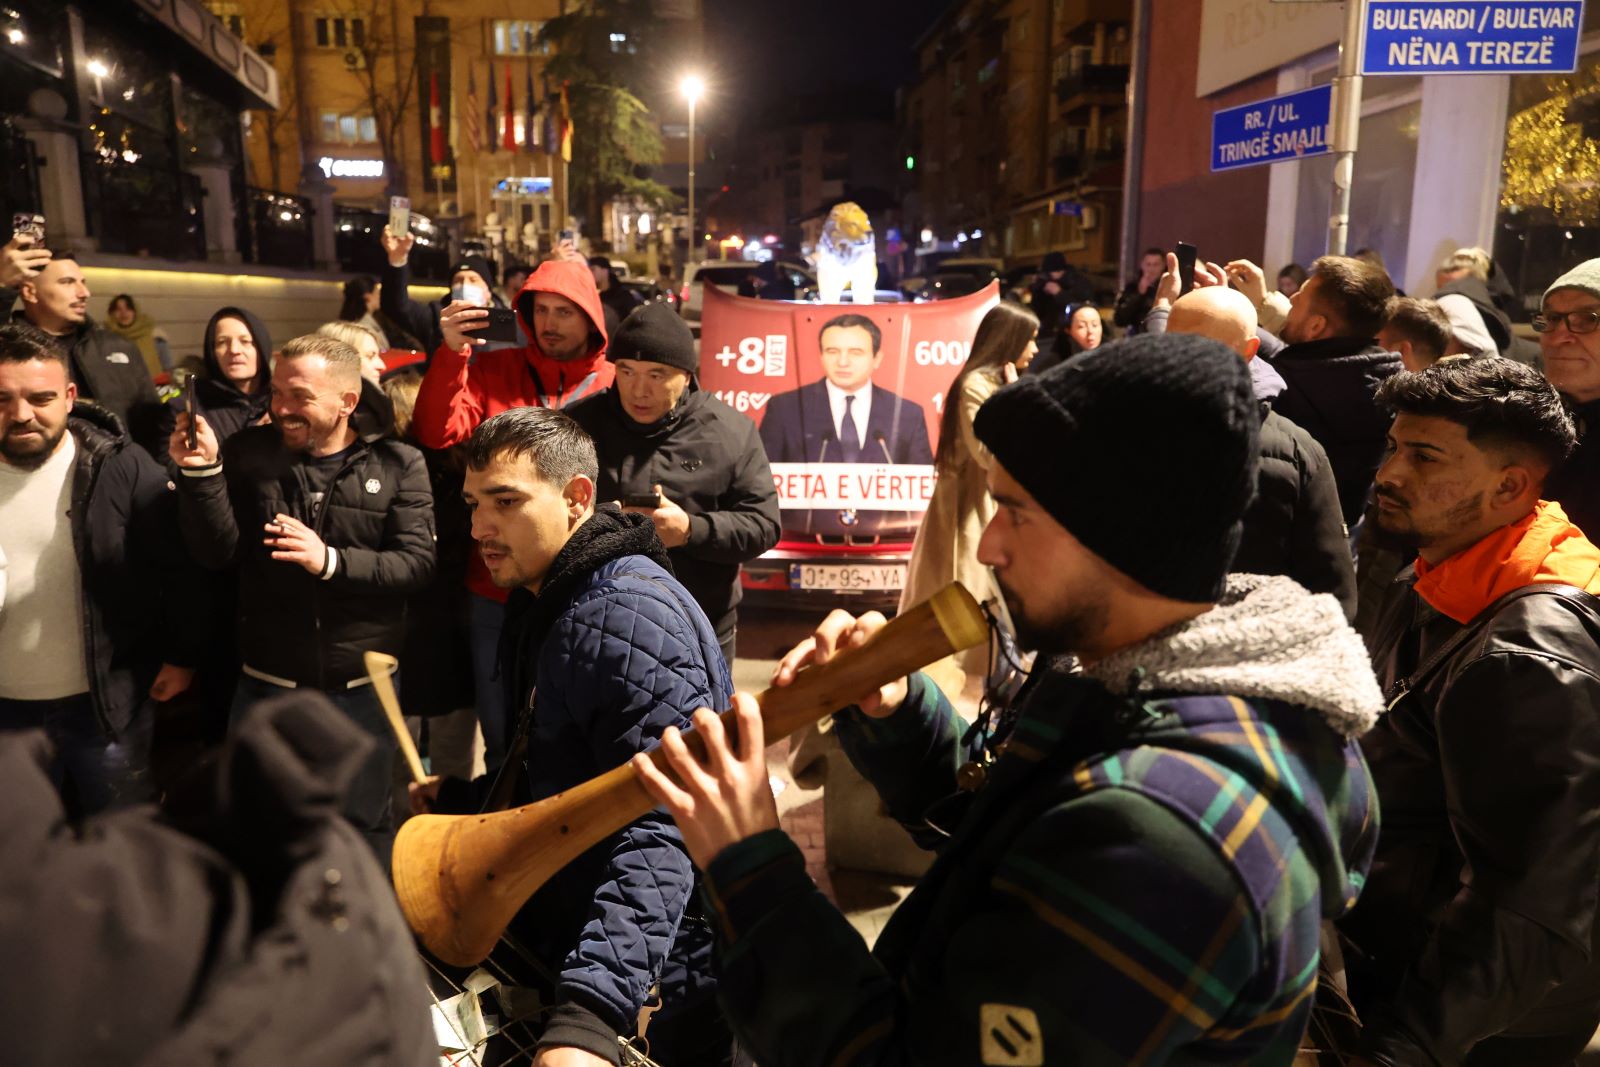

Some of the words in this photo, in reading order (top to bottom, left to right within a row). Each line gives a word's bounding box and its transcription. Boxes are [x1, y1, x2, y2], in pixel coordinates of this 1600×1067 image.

[1373, 8, 1475, 30] BULEVARDI
[1477, 6, 1491, 33] /
[1493, 7, 1575, 29] BULEVAR
[1388, 36, 1459, 66] NËNA
[1466, 36, 1554, 65] TEREZË
[1244, 110, 1265, 130] RR.
[1267, 105, 1276, 129] /
[1278, 103, 1299, 123] UL.
[1219, 131, 1270, 163] TRINGË
[769, 338, 784, 373] VJET
[838, 474, 849, 499] E
